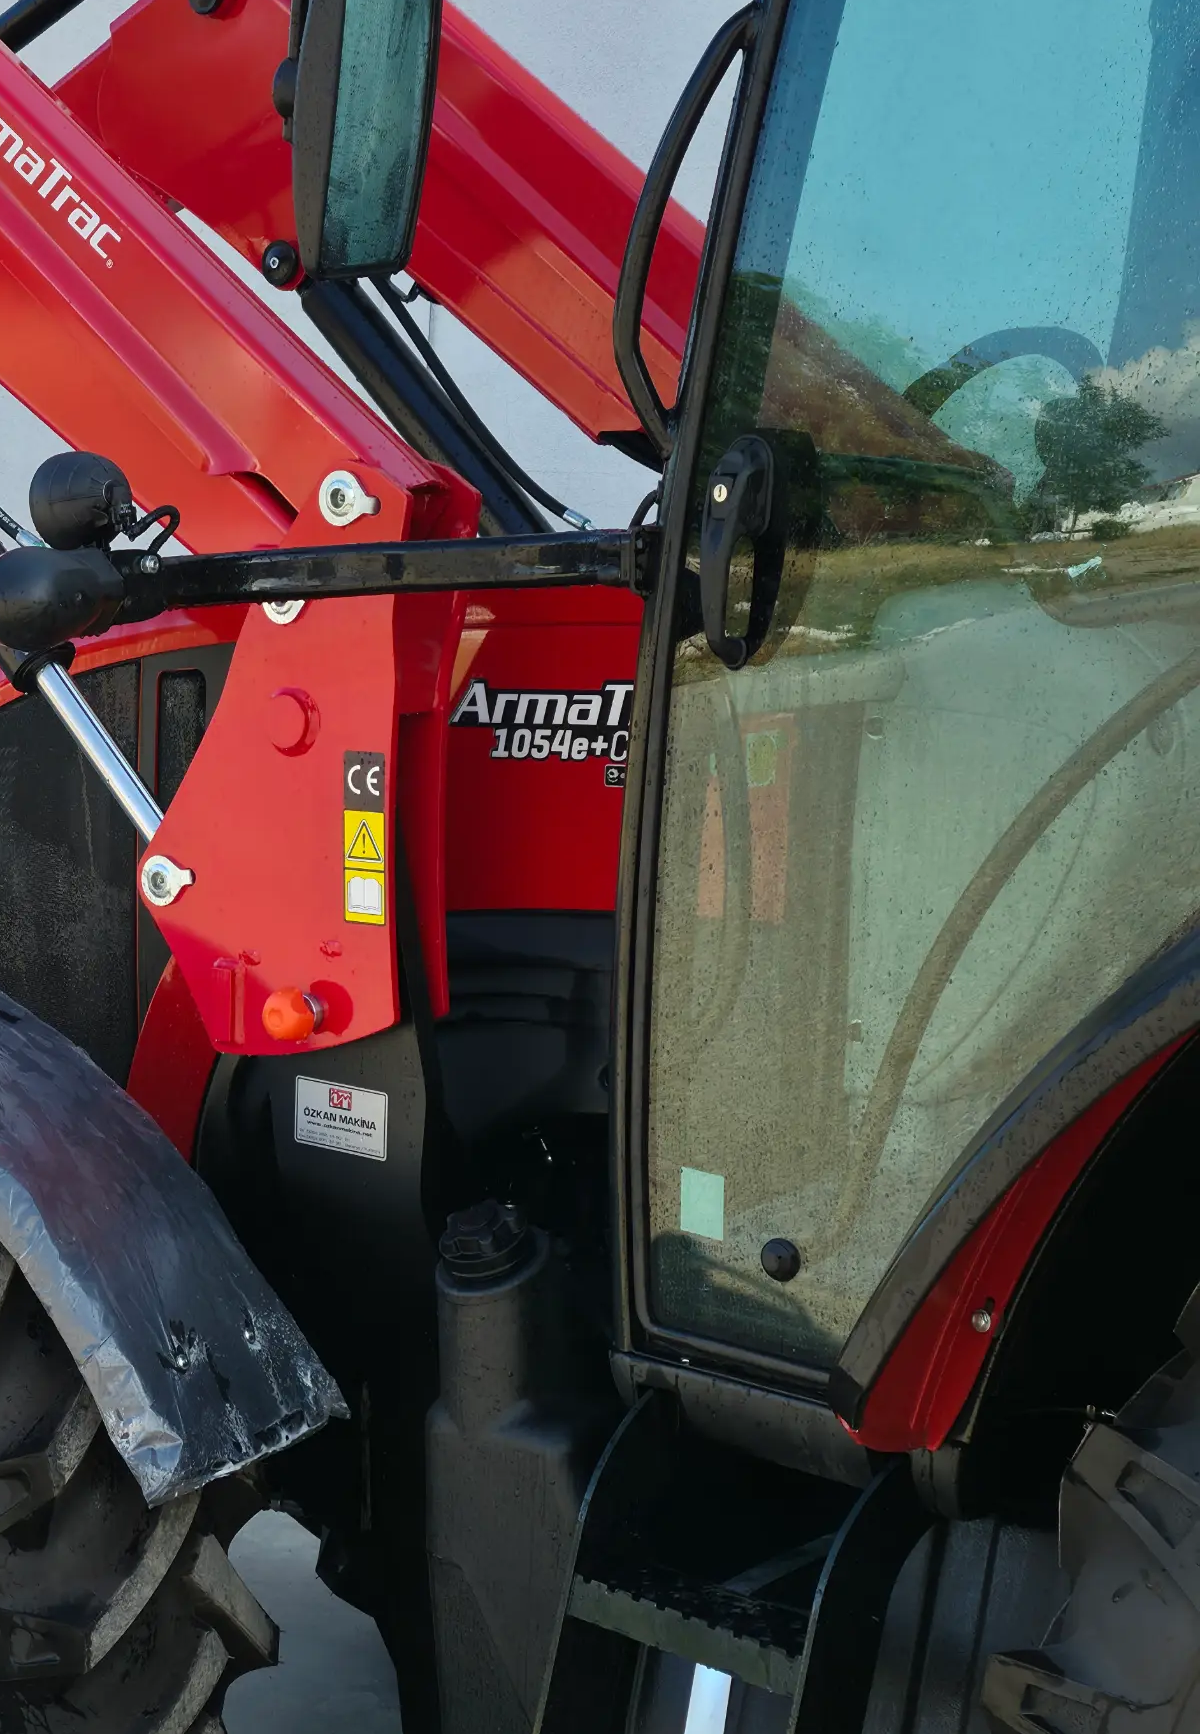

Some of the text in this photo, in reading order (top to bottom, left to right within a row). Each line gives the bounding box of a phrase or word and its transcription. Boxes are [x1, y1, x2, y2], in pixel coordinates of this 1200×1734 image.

[452, 682, 634, 726] ArmaT
[347, 765, 380, 796] CE
[303, 1106, 377, 1131] ÖZKAN MAKİNA
